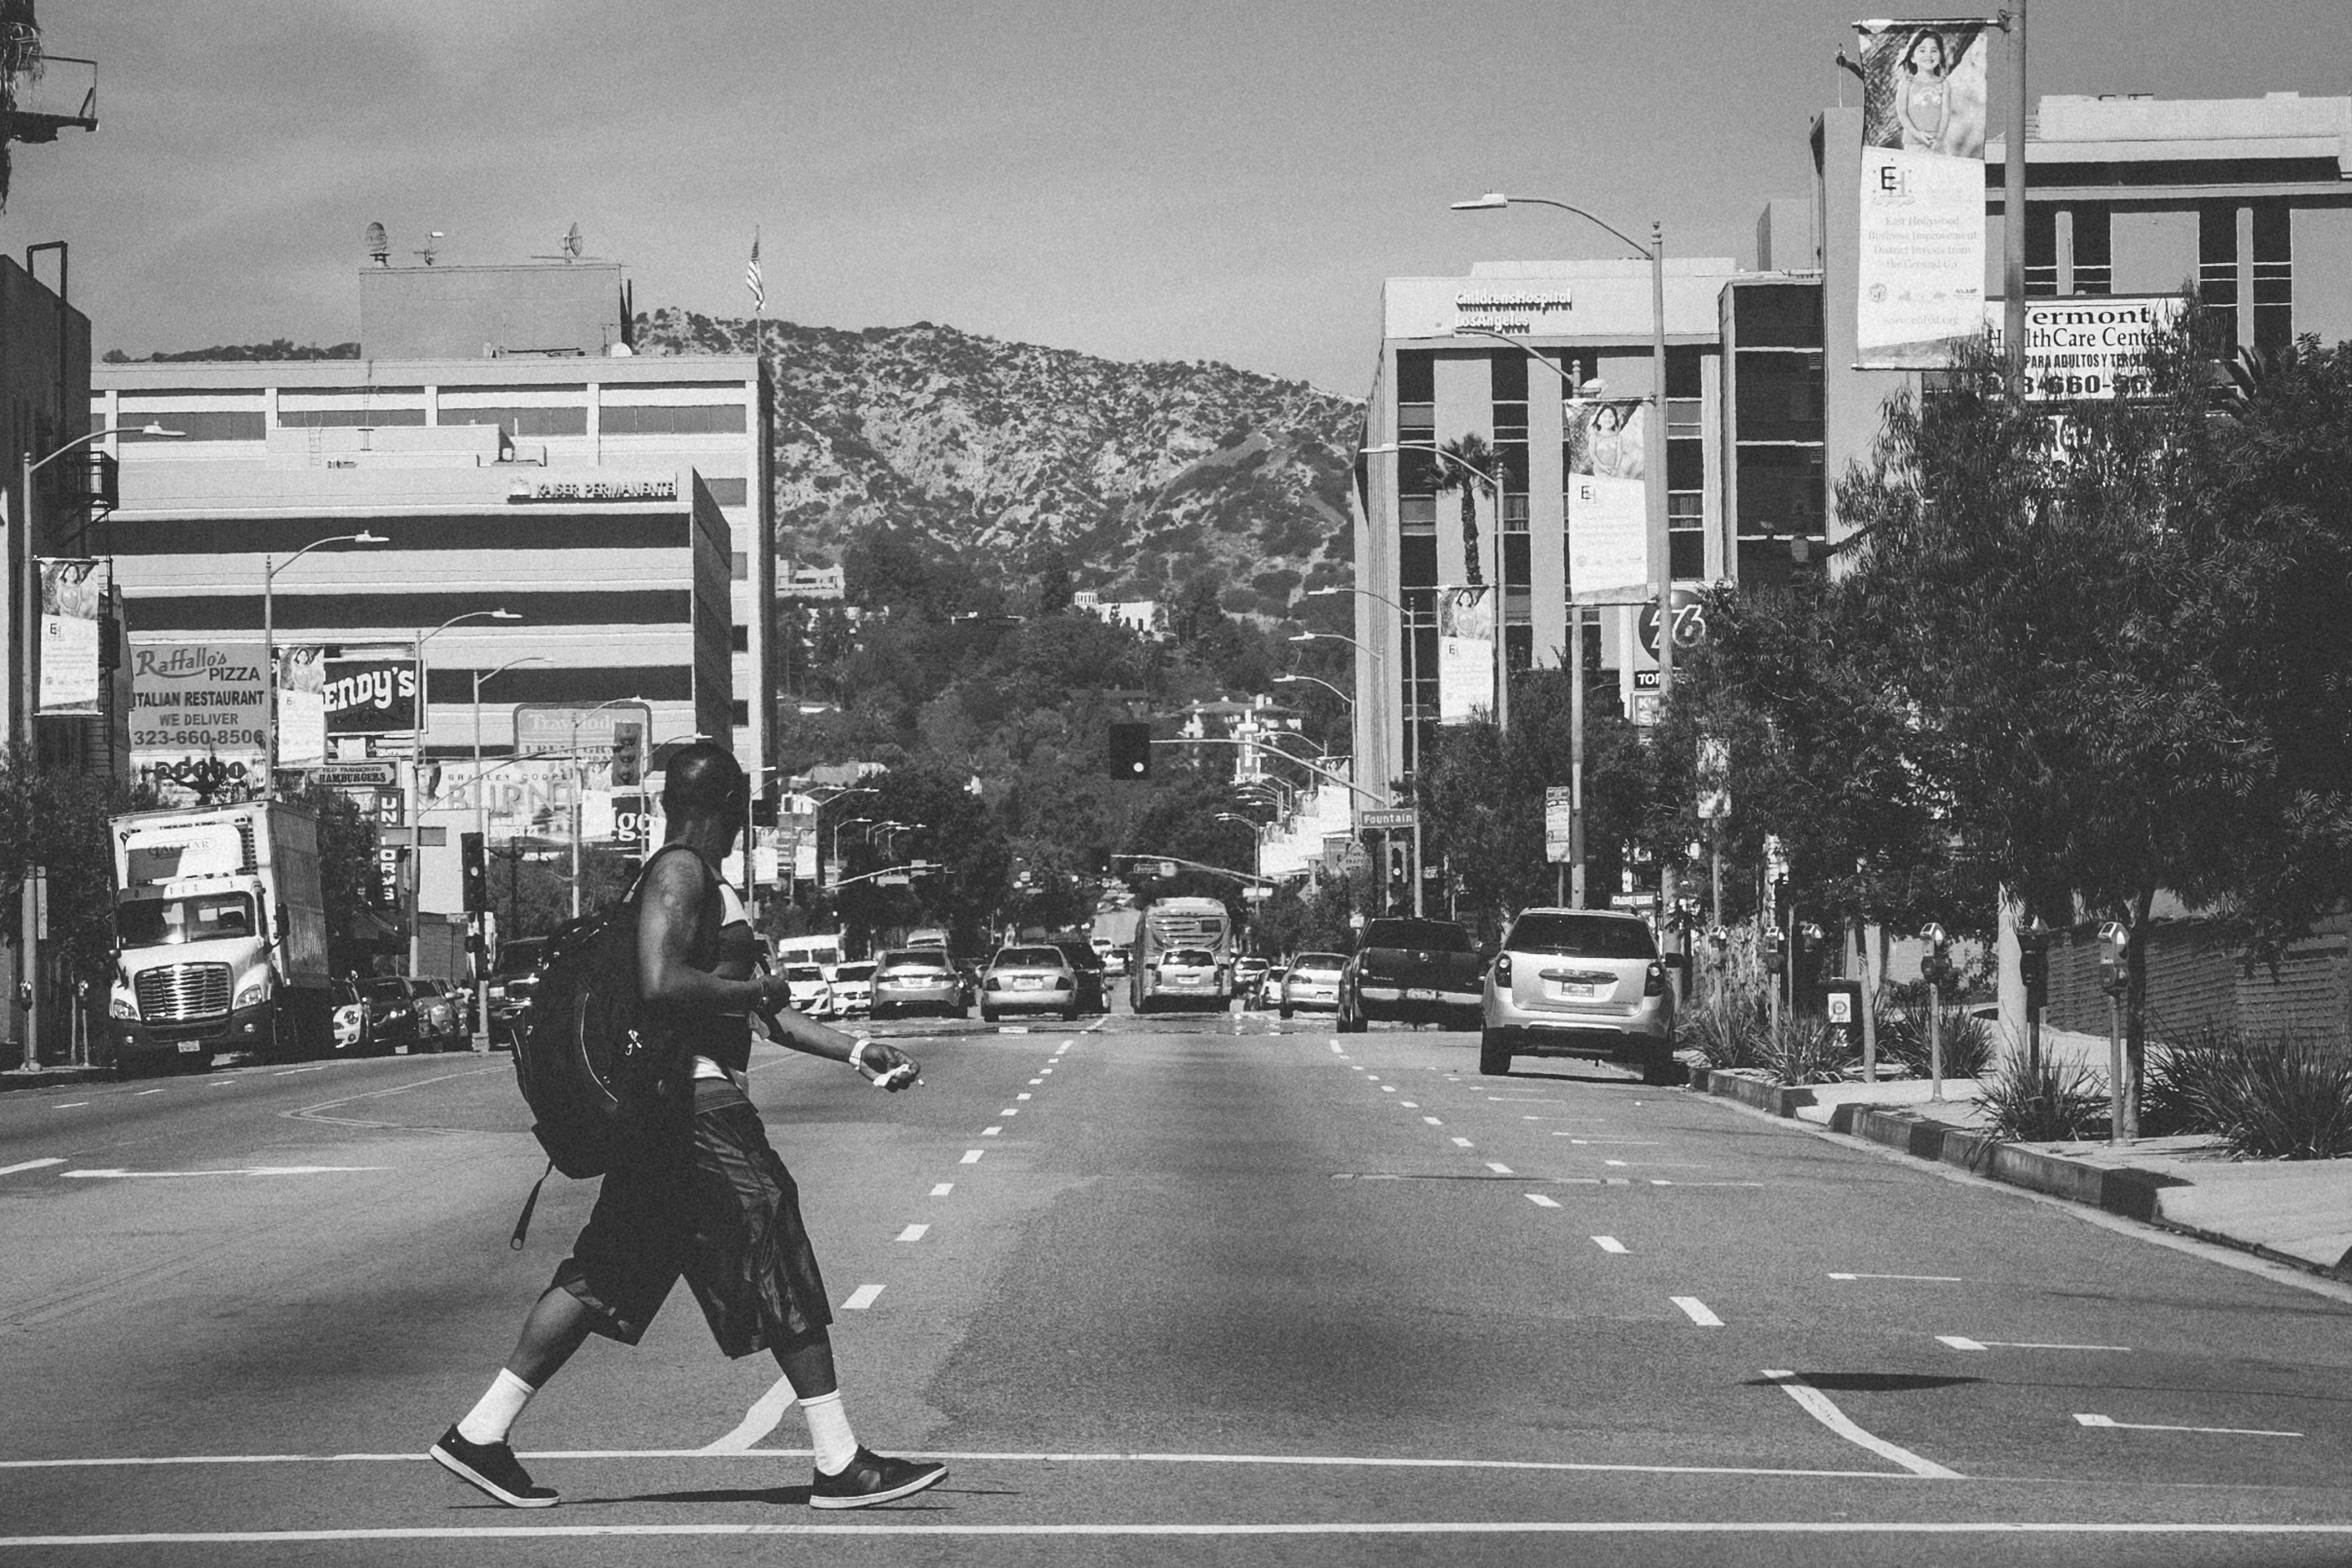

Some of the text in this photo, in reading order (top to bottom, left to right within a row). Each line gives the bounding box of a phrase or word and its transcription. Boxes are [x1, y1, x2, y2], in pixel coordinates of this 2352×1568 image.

[1908, 216, 1960, 228] Hollywood
[1868, 231, 1977, 243] Business Improvement
[1873, 245, 1909, 255] District
[1948, 244, 1971, 255] from
[1886, 257, 1958, 270] the Ground Up
[2054, 354, 2099, 368] ADULTOS
[2101, 353, 2108, 368] Y
[537, 481, 677, 498] KAISER PERMANENTE
[135, 647, 228, 679] Raffallo's
[209, 666, 261, 681] PIZZA
[185, 691, 265, 707] RESTAURANT
[159, 712, 238, 726] WE DELIVER
[134, 729, 265, 746] 323-660-8506
[318, 772, 387, 783] HAMBURGERS
[1364, 813, 1413, 825] Fountain
